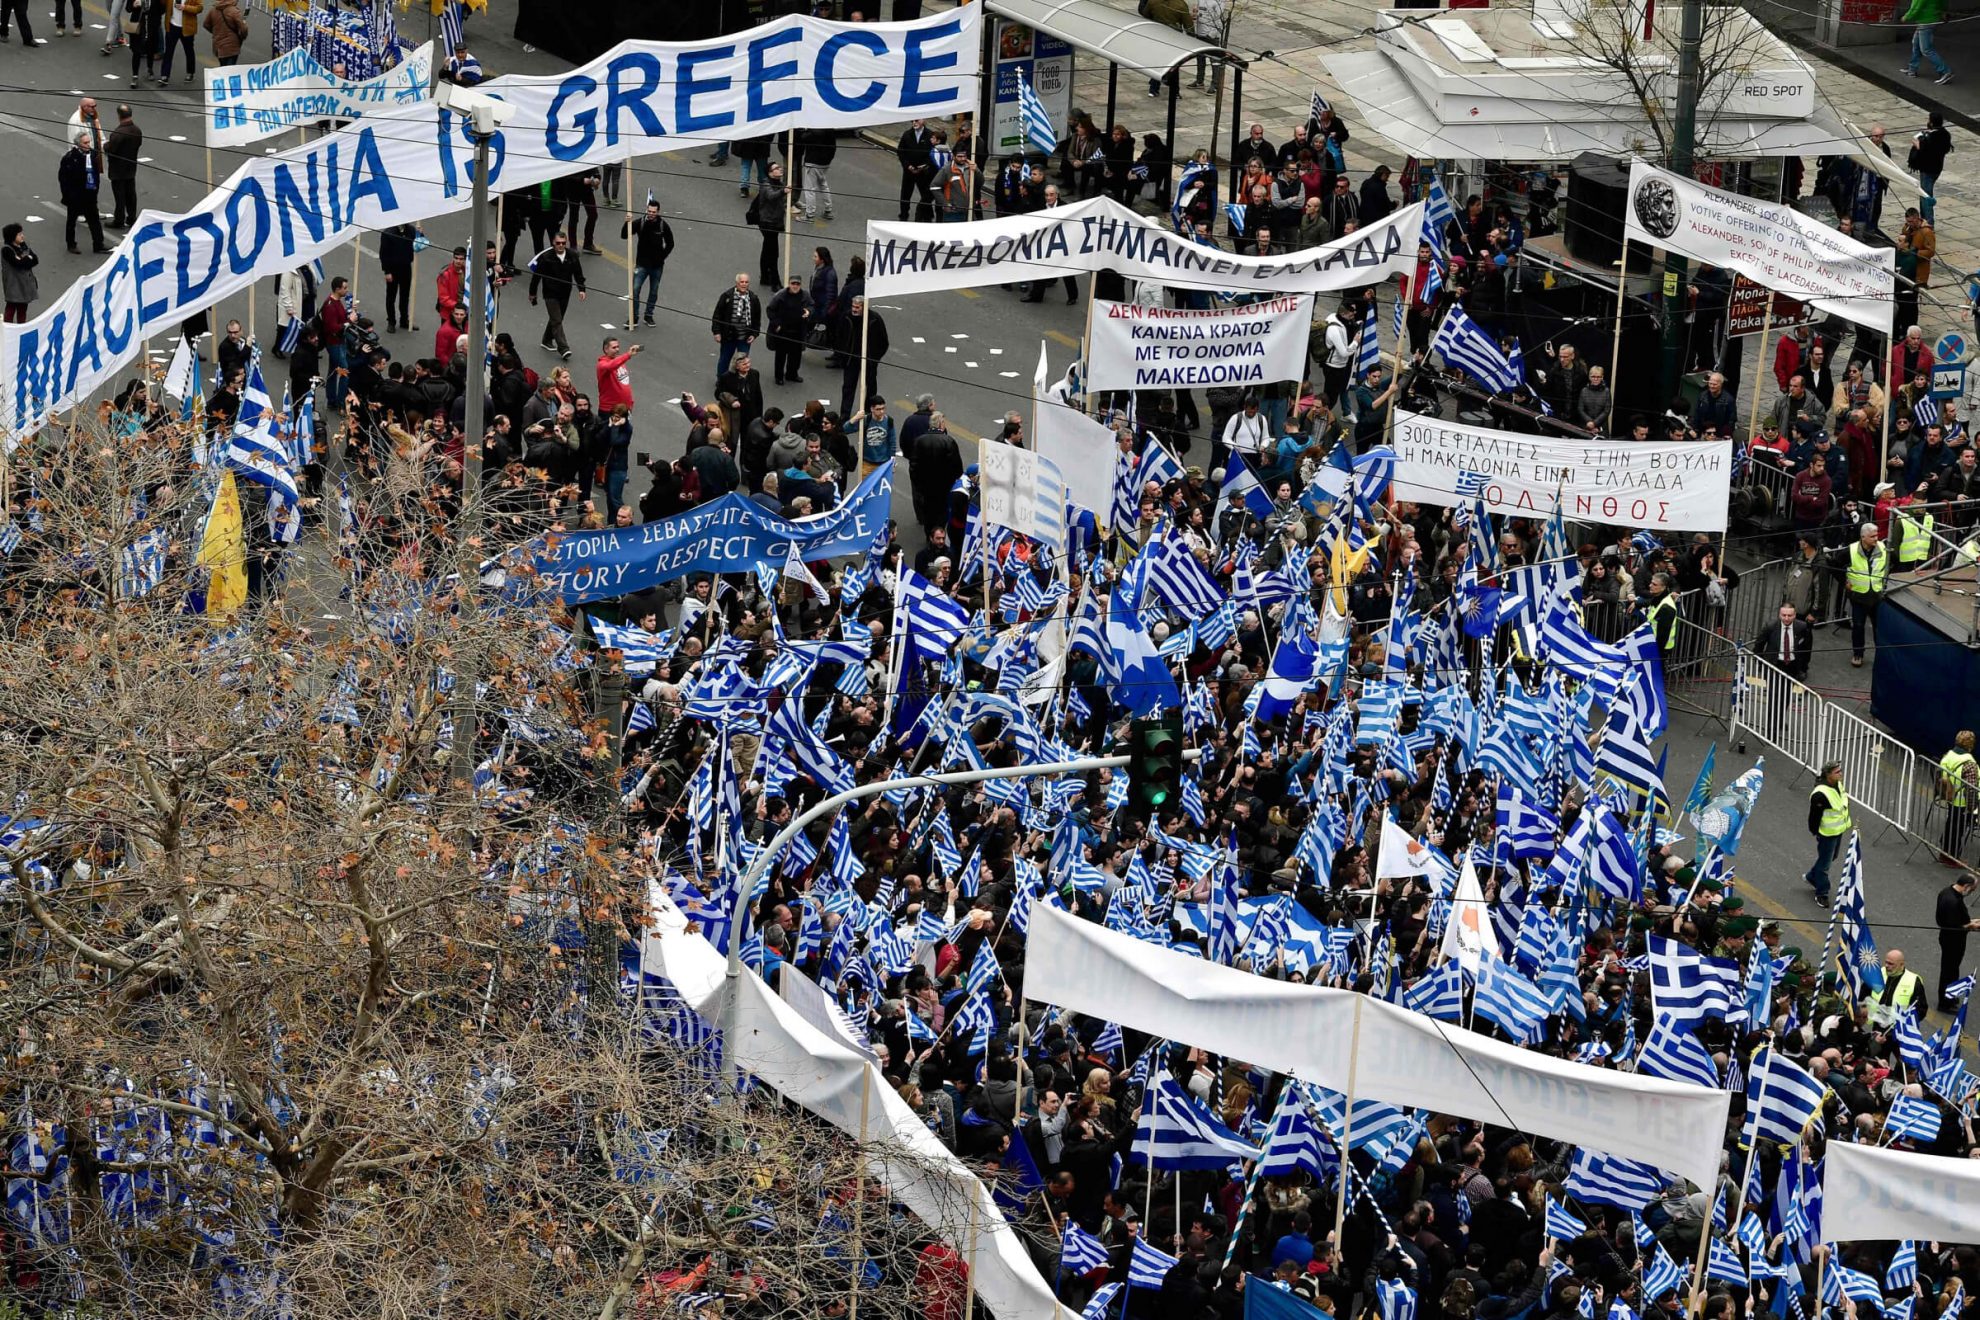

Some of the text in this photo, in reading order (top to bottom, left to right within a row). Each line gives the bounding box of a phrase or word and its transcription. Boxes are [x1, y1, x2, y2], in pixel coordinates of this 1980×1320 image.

[1772, 85, 1804, 97] SPOT
[15, 126, 399, 430] MACEDONIA
[437, 92, 506, 198] IS
[546, 19, 963, 162] GREECE
[1690, 203, 1722, 222] VOTIVE
[1726, 215, 1772, 237] OFFERING
[1789, 236, 1808, 251] THE
[1805, 230, 1820, 242] OF
[869, 215, 1402, 280] ΜΑΚΕΔΟΝΙΑ ΣΗΜΑΙΝΕΙ ΕΛΛΑΔΑ
[1767, 246, 1779, 258] OF
[1783, 252, 1814, 272] PHILIP
[1816, 265, 1834, 280] AND
[1835, 273, 1847, 286] ALL
[1850, 278, 1863, 292] THE
[1108, 304, 1143, 320] ΔΕΝ
[1131, 320, 1273, 340] ΚΑΝΕΝΑ ΚΡΑΤΟΣ
[1135, 341, 1266, 361] ΜΕ ΤΟ ΟΝΟΜΑ
[1135, 363, 1264, 385] ΜΑΚΕΔΟΝΙΑ
[1402, 425, 1721, 471] 300 ΕΦΙΑΛΤΕΣ ΣΤΗΝ ΒΟΥΛΗ
[1404, 446, 1414, 463] Η
[1421, 449, 1522, 479] ΜΑΚΕΔΟΝΙΑ
[1594, 469, 1684, 491] ΕΛΛΑΔΑ
[1486, 485, 1670, 523] ΟΛΝΘΟΣ
[515, 562, 631, 601] HSTORY
[655, 536, 757, 576] RESPECT
